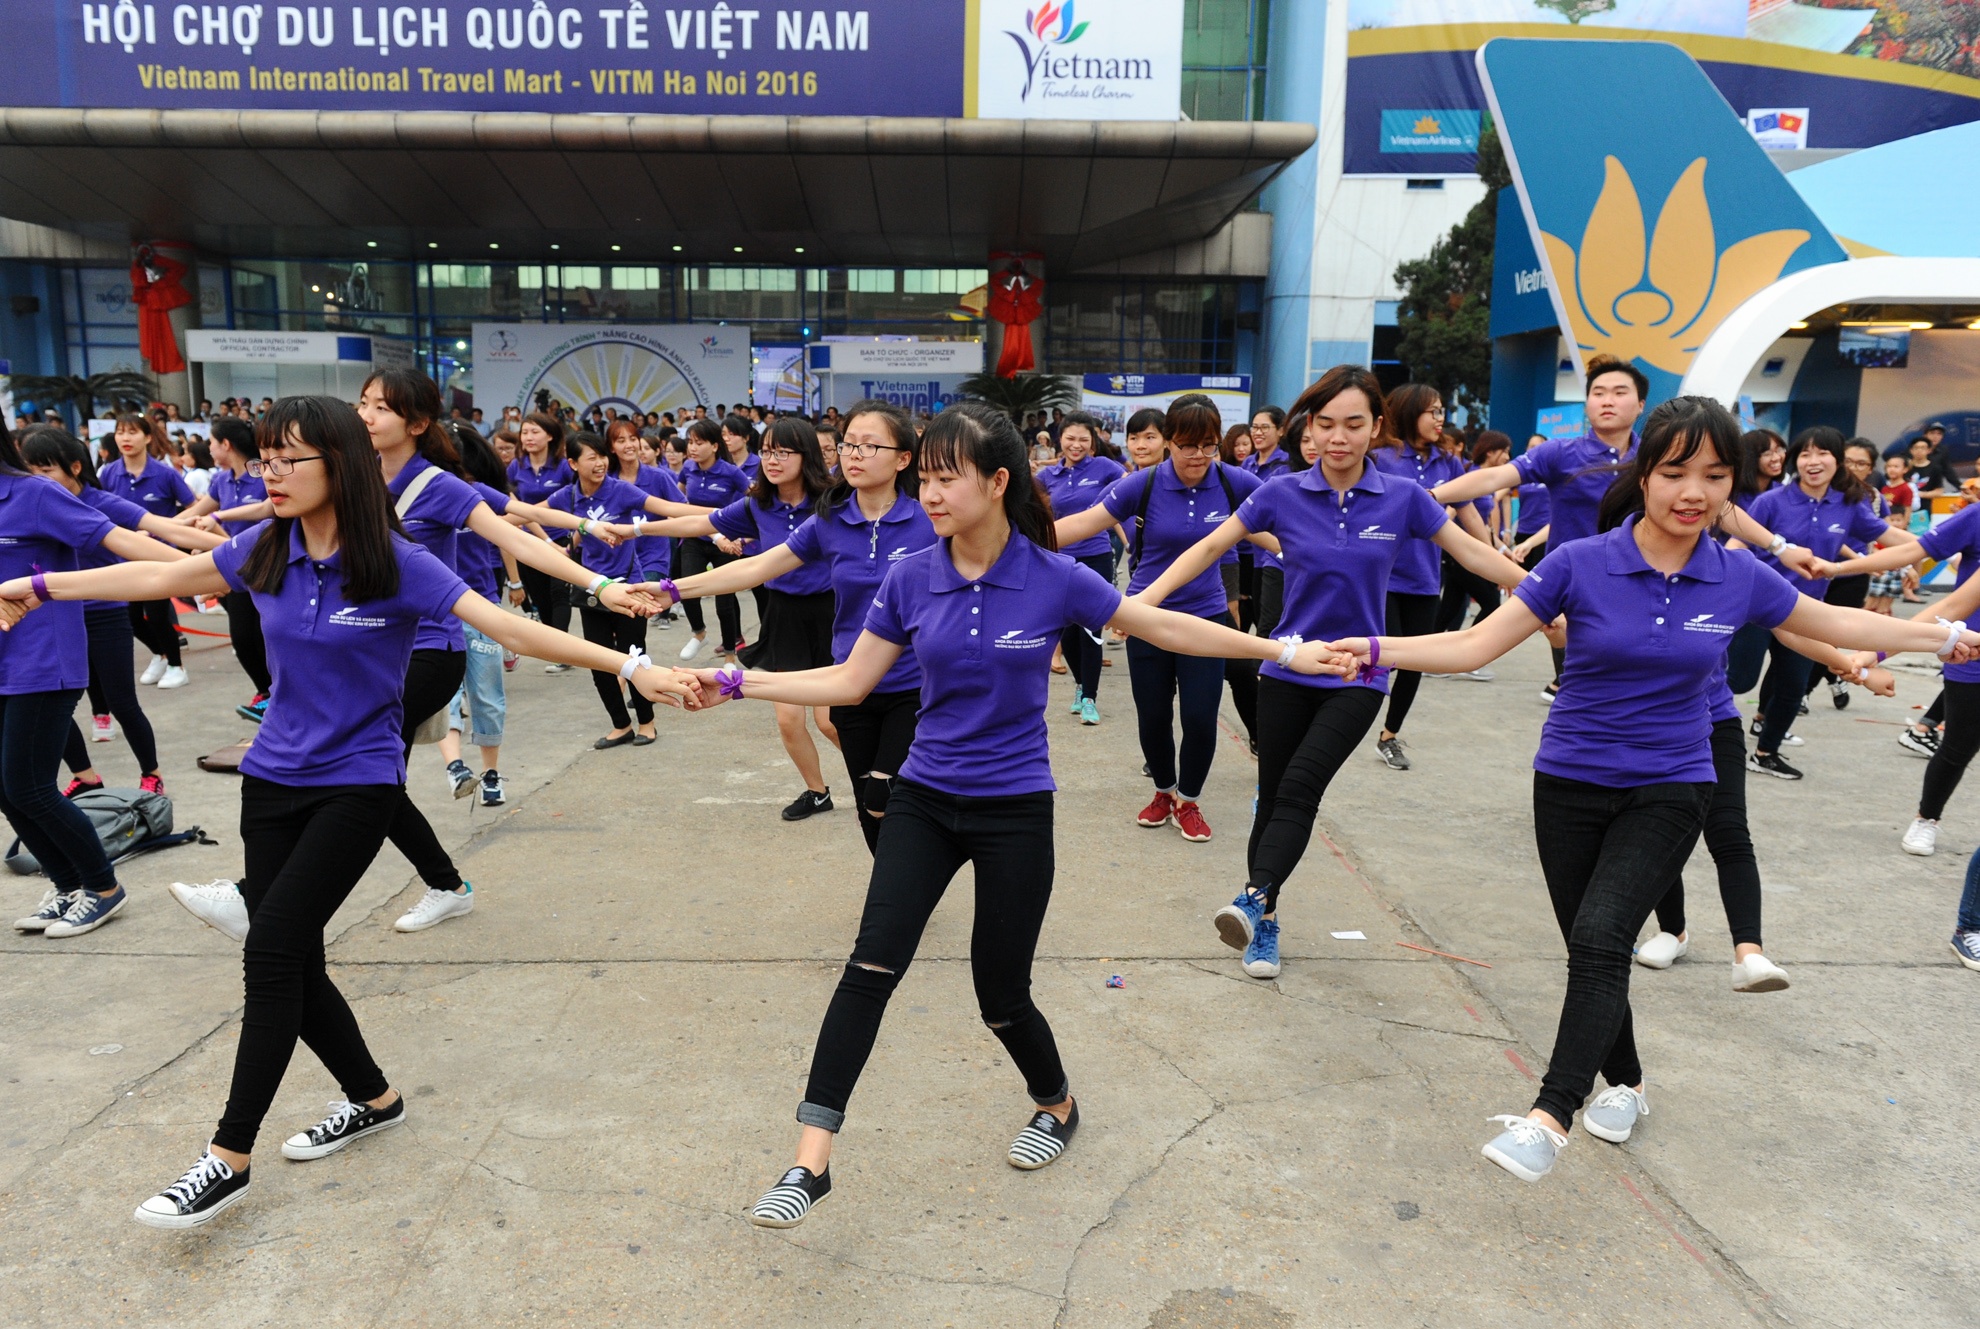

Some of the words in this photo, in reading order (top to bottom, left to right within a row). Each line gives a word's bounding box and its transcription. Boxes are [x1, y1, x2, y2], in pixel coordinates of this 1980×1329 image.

[82, 0, 156, 53] HỘI
[172, 3, 263, 55] CHỢ
[277, 6, 334, 47] DU
[352, 7, 448, 56] LỊCH
[466, 0, 583, 51] QUỐC
[598, 0, 649, 50] TẾ
[665, 1, 760, 59] VIỆT
[775, 11, 869, 51] NAM
[137, 64, 240, 90] Vietnam
[249, 66, 409, 92] International
[417, 68, 494, 93] Travel
[503, 69, 563, 94] Mart
[590, 70, 653, 95] VITM
[663, 70, 697, 95] Ha
[706, 71, 747, 96] Noi
[756, 71, 818, 96] 2016
[1002, 31, 1153, 103] Vietnam
[1042, 81, 1089, 99] Timeless
[1091, 84, 1135, 99] Charm
[1514, 268, 1548, 296] Vietn
[629, 332, 647, 343] CAO
[877, 381, 927, 392] Vietnam
